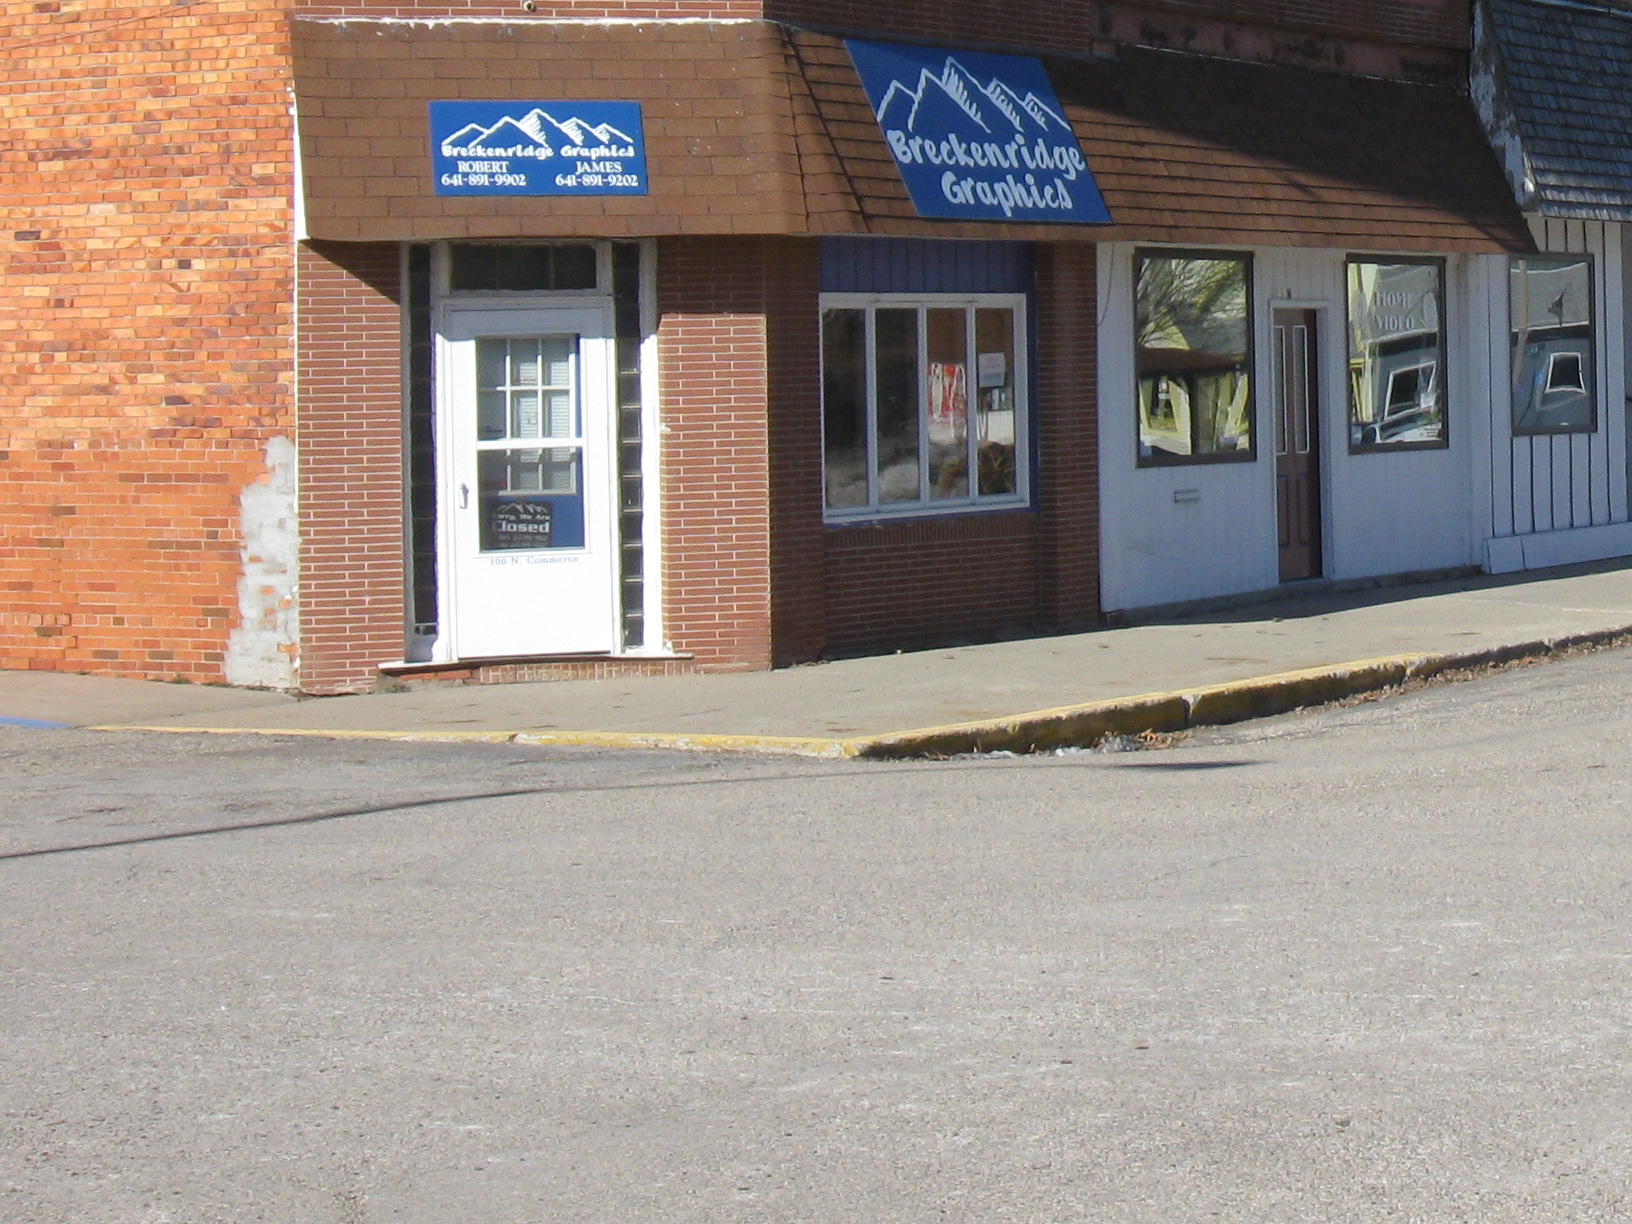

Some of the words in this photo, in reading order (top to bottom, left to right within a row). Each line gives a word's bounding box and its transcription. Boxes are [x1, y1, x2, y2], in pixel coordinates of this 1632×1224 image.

[441, 144, 555, 160] Breckenridge
[560, 144, 635, 160] Graphics
[886, 129, 1087, 180] Breckenridge
[457, 161, 510, 172] ROBERT
[575, 161, 622, 175] JAMES
[441, 174, 527, 187] 641-891-9902
[555, 174, 639, 188] 641-891-9202
[941, 171, 1073, 217] Graphics
[1374, 291, 1415, 308] HOME
[1373, 315, 1414, 331] VIDEO
[492, 521, 550, 534] Closed
[526, 556, 579, 565] Commerce
